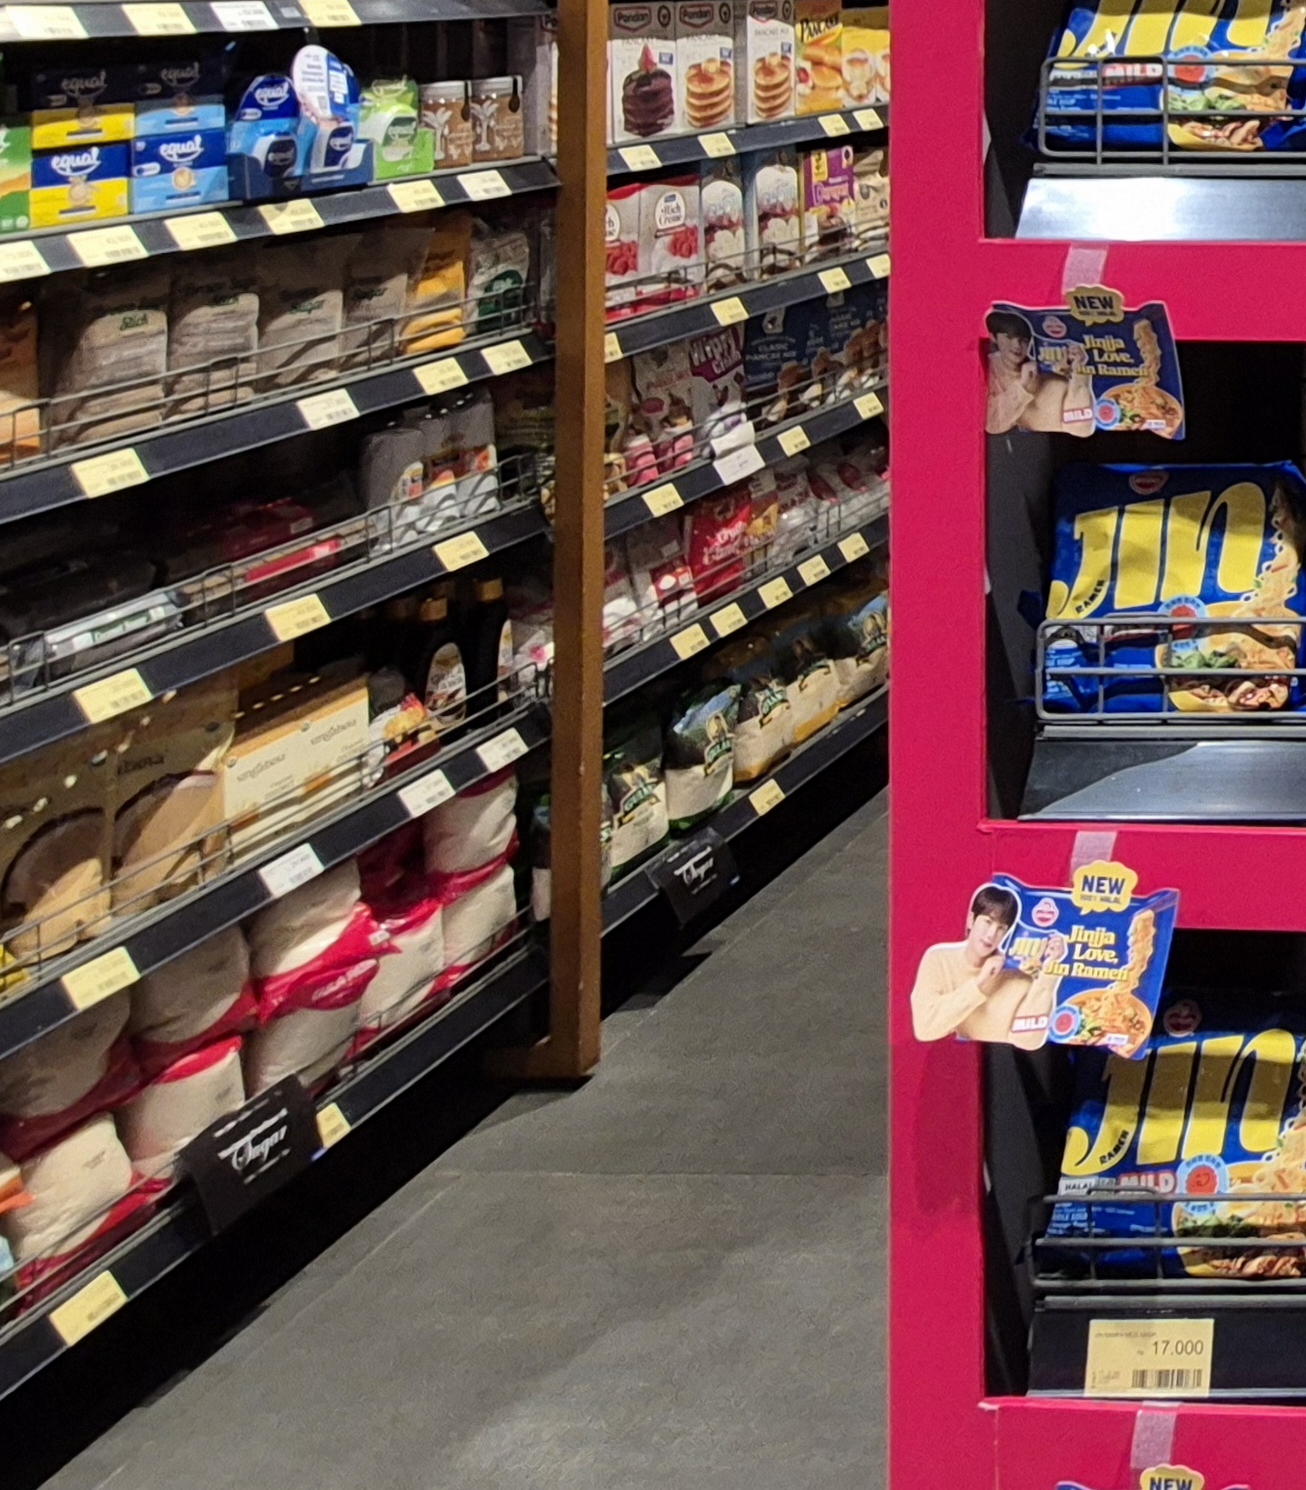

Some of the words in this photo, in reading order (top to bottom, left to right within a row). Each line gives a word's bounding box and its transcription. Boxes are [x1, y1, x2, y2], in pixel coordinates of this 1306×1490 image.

[254, 82, 290, 104] equal
[159, 135, 203, 162] equal
[51, 146, 101, 176] equal
[1073, 295, 1115, 310] NEW
[1074, 579, 1107, 615] RAMEN
[1081, 875, 1126, 896] NEW
[1067, 925, 1116, 950] Jinjja
[1071, 962, 1129, 982] Ramen
[1012, 1016, 1049, 1033] MILD
[1098, 1128, 1130, 1166] RAMEN
[1119, 1172, 1177, 1197] MILD
[1150, 1477, 1193, 1490] NEW
